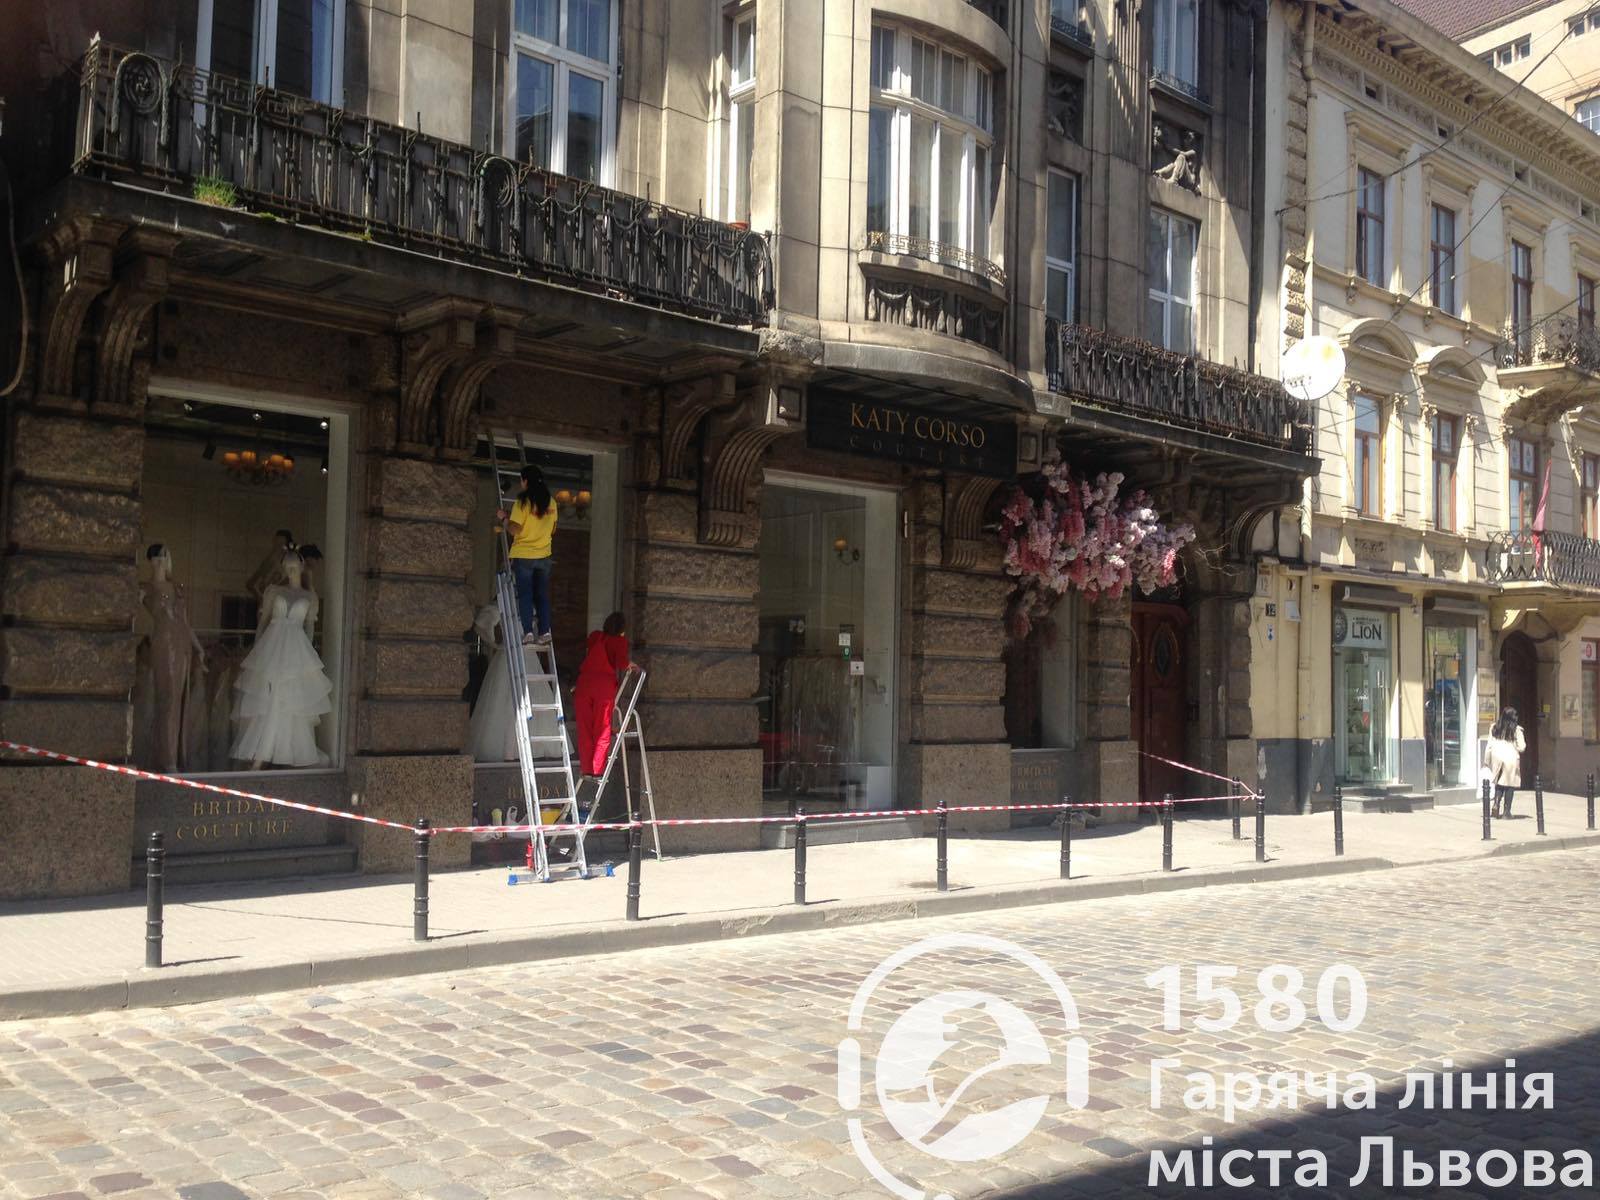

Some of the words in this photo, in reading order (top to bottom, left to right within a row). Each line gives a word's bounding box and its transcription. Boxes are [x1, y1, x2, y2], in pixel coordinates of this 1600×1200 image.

[851, 402, 910, 435] KATY
[914, 415, 985, 449] CORSO
[193, 799, 281, 817] BRIDAL
[176, 819, 294, 840] COUTURE
